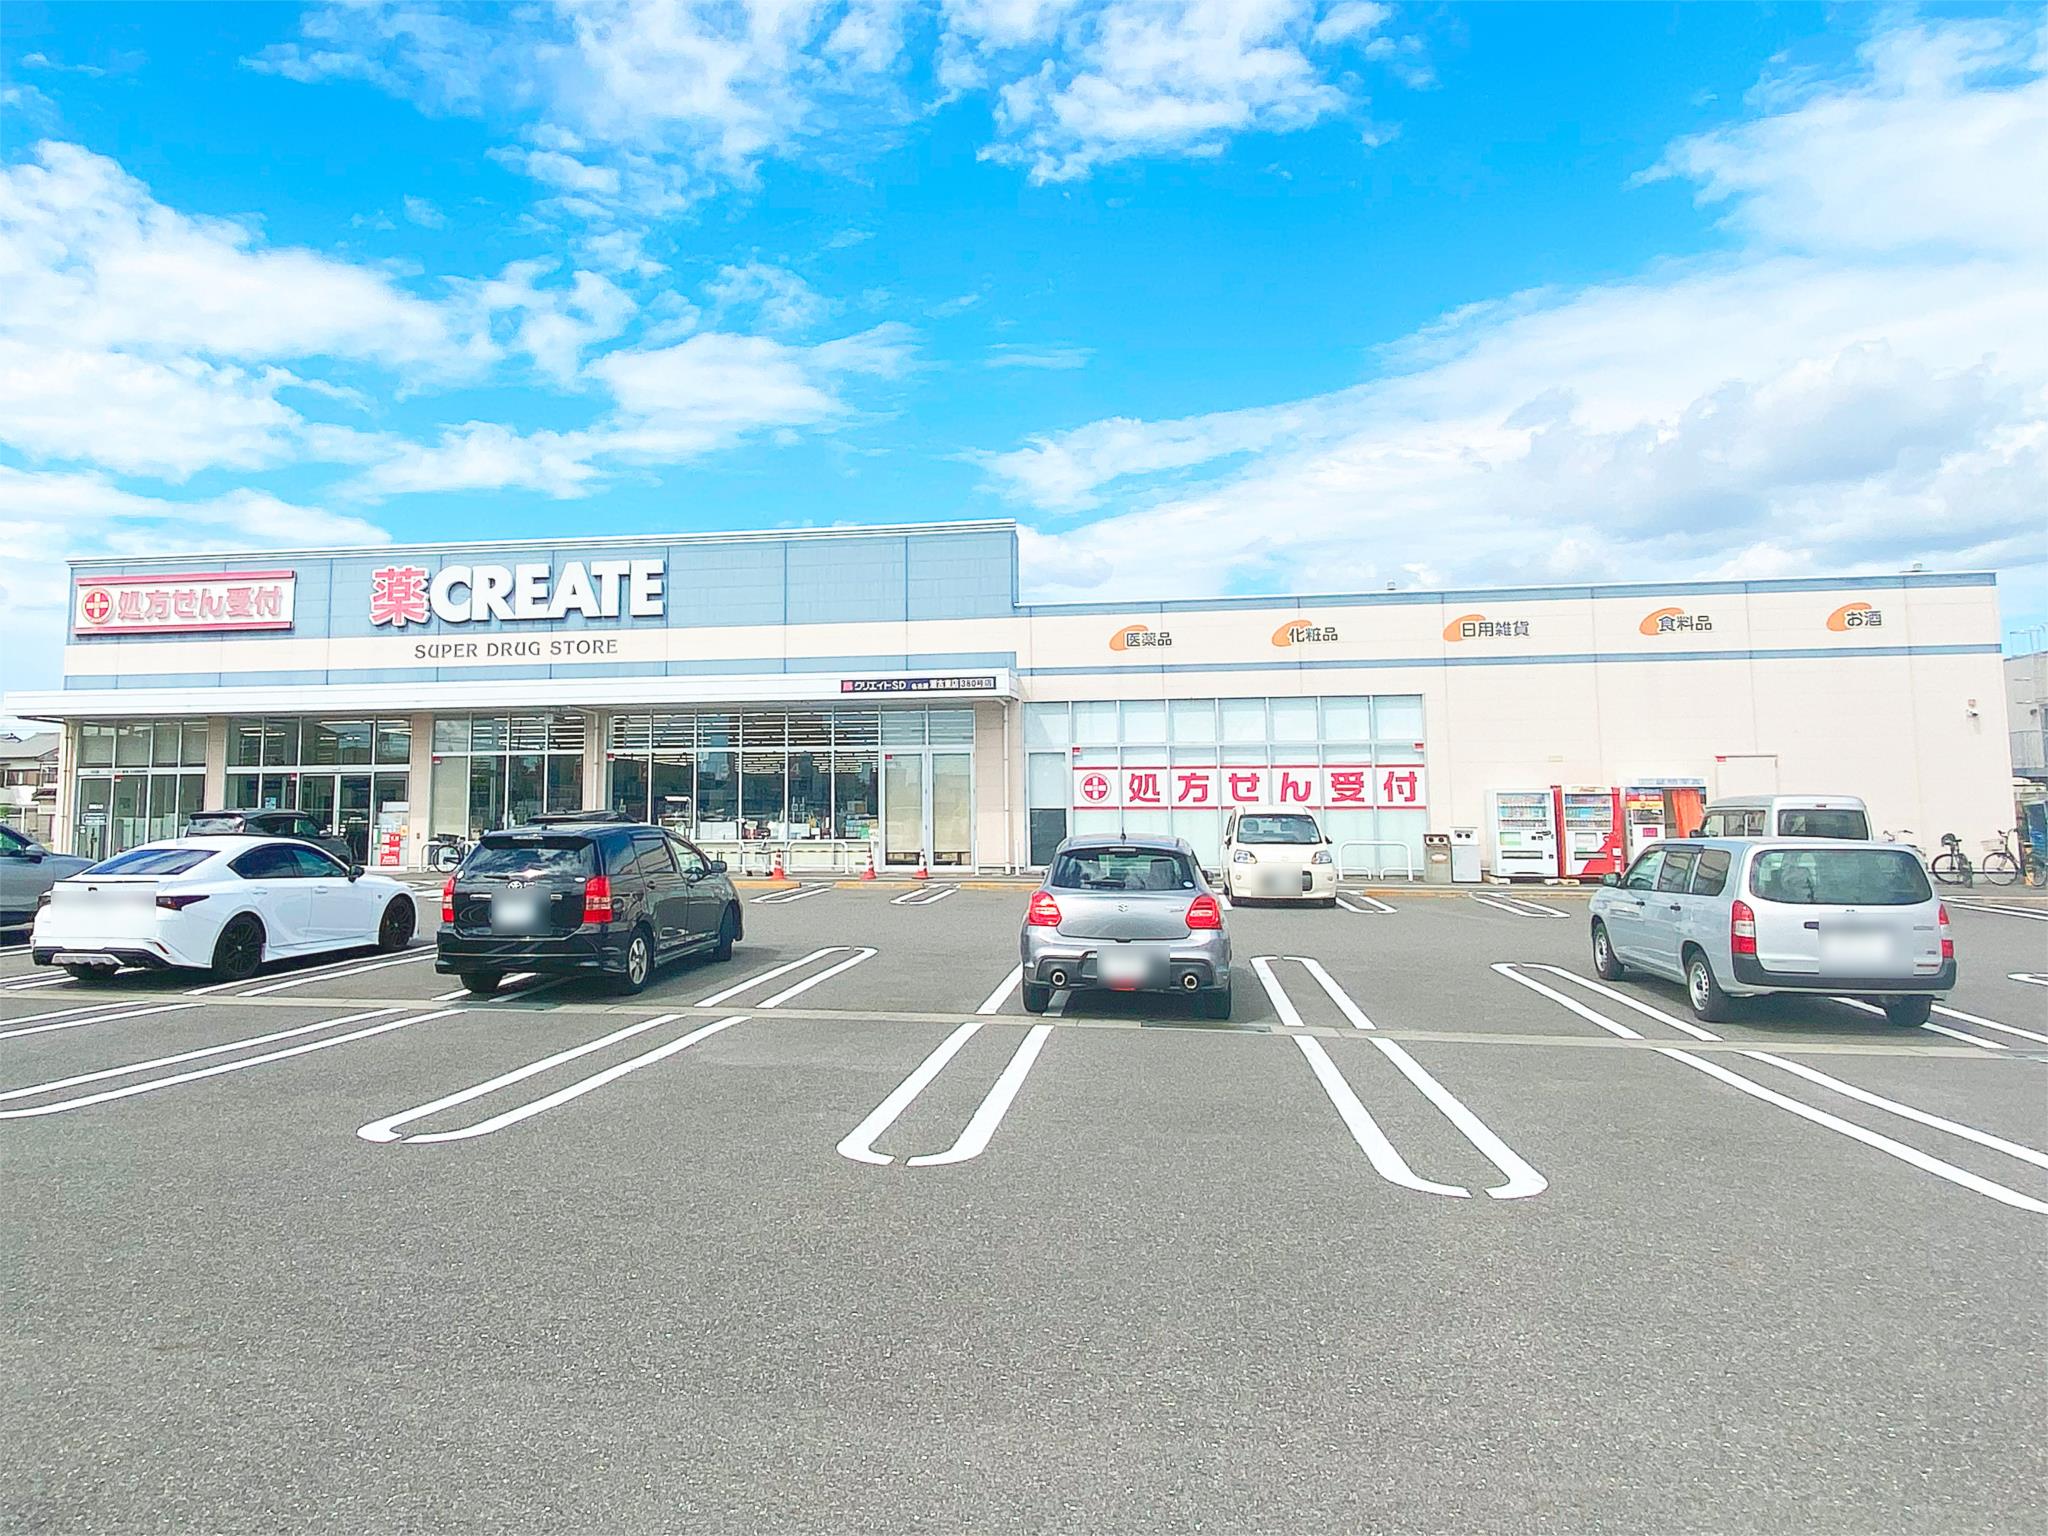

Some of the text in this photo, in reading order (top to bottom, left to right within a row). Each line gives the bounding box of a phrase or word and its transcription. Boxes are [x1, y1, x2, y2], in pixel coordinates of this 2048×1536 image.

[368, 559, 666, 627] 薬 CREATE
[118, 586, 284, 620] 処方せん受付
[1658, 615, 1713, 632] 食料品
[1846, 610, 1883, 627] お酒
[1288, 626, 1339, 644] 化粧品
[1462, 620, 1531, 638] 日用雑貨
[1126, 631, 1173, 648] 医薬品
[414, 639, 619, 659] SUPER DRUG STORE
[854, 680, 907, 691] クリエイトSD
[1128, 771, 1418, 803] 処方せん受付
